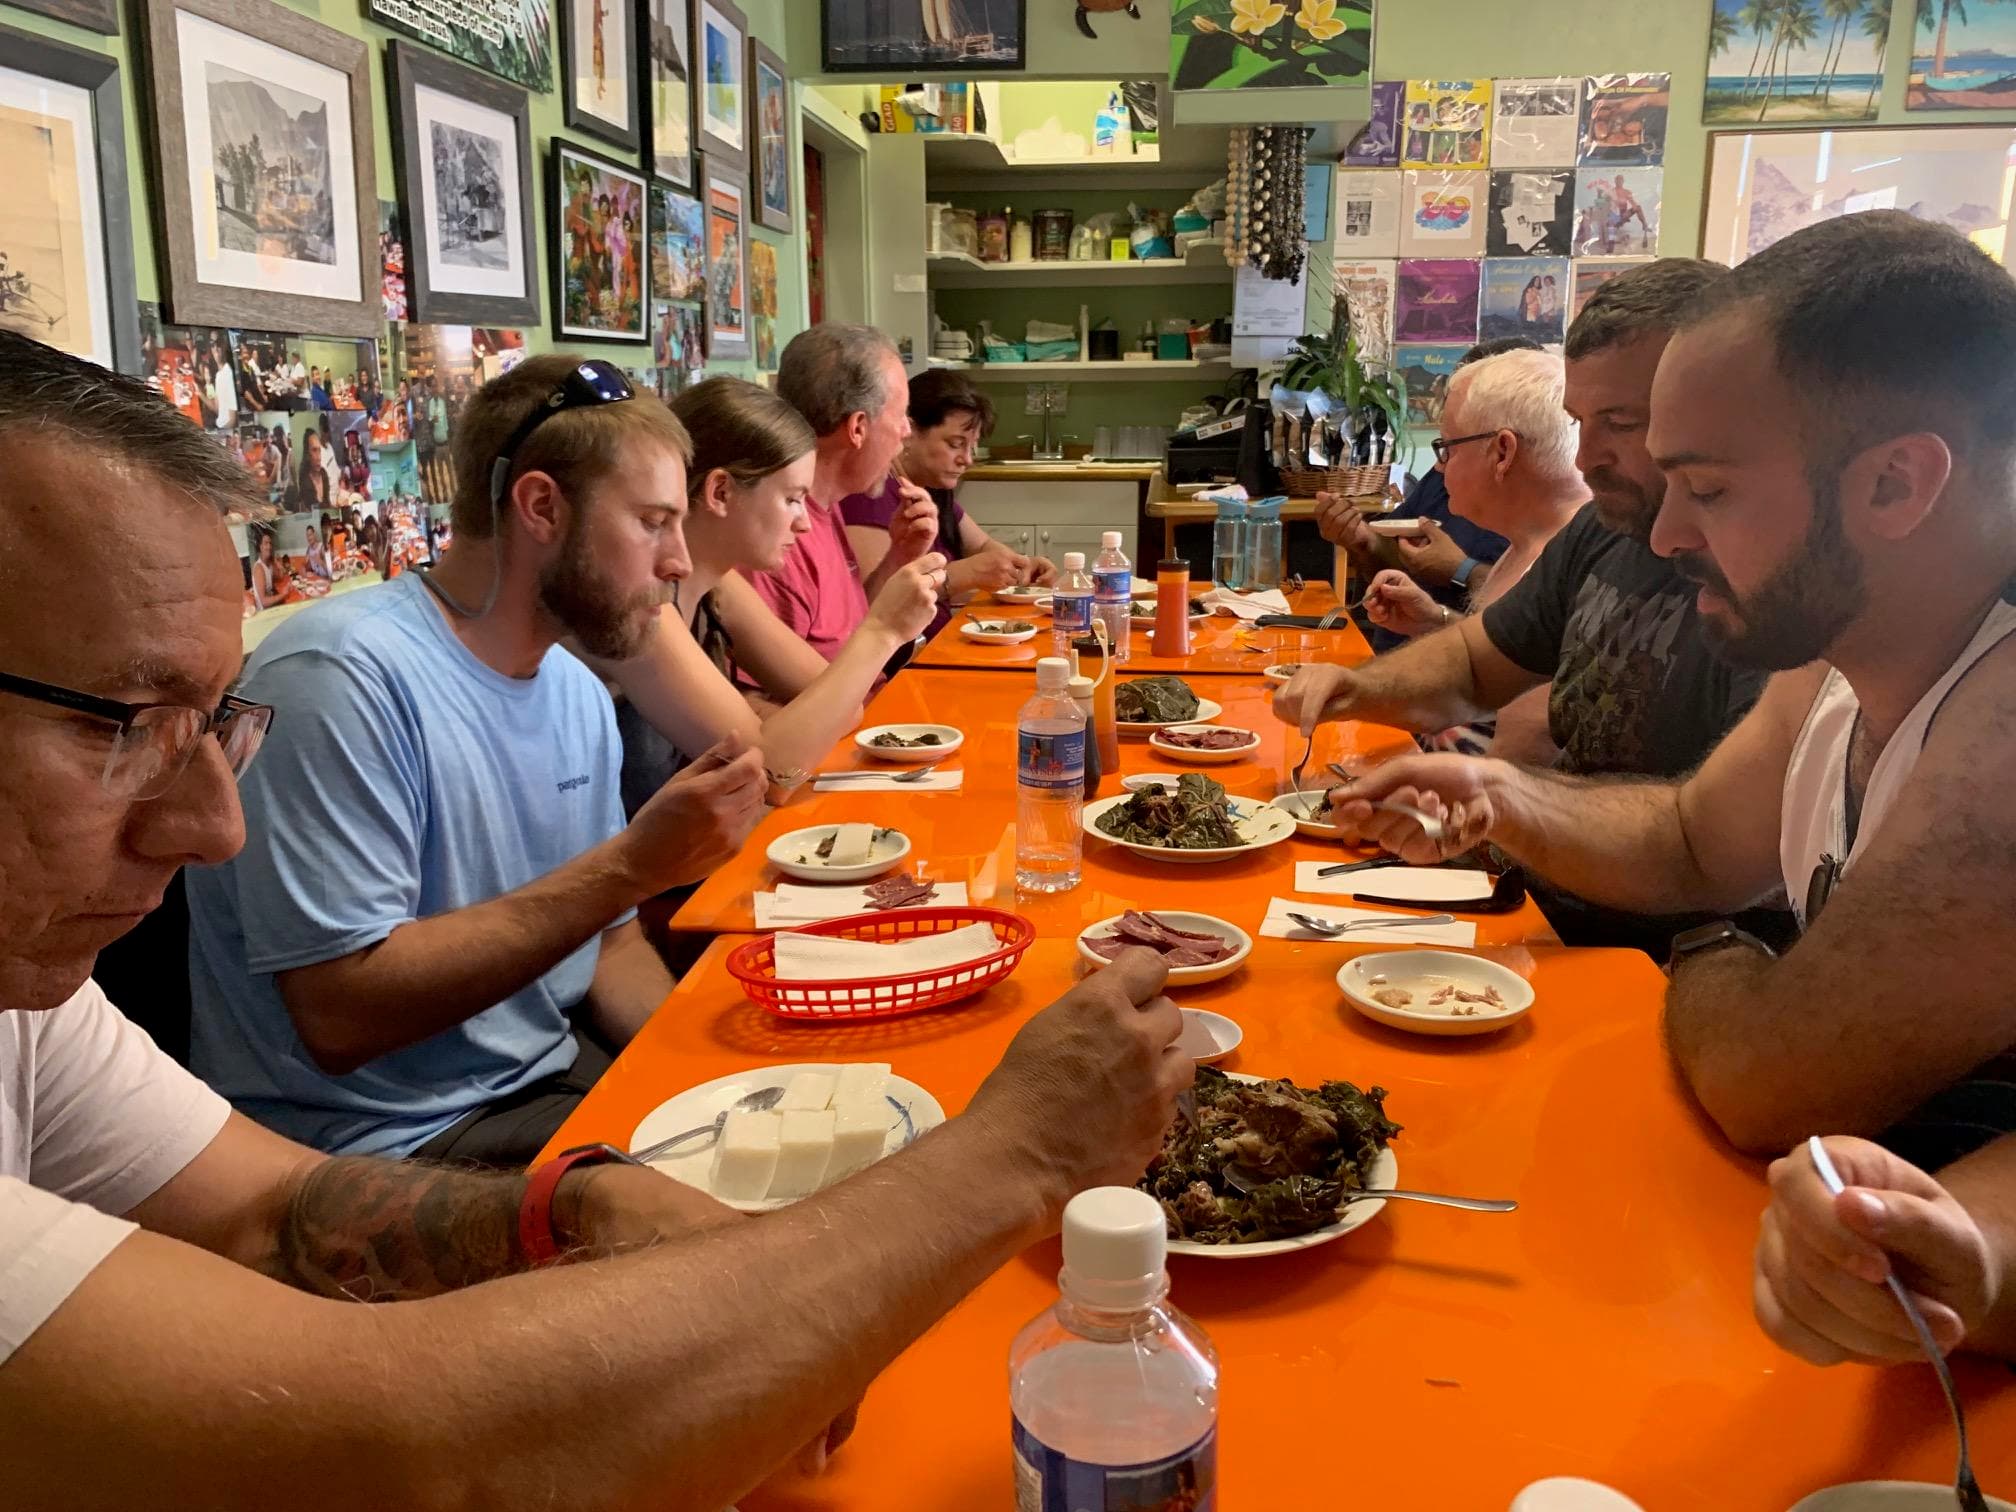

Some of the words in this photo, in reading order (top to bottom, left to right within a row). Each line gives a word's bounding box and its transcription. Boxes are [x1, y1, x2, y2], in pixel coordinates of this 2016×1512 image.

[470, 15, 479, 32] of
[480, 22, 503, 48] many
[882, 103, 896, 131] GLAD
